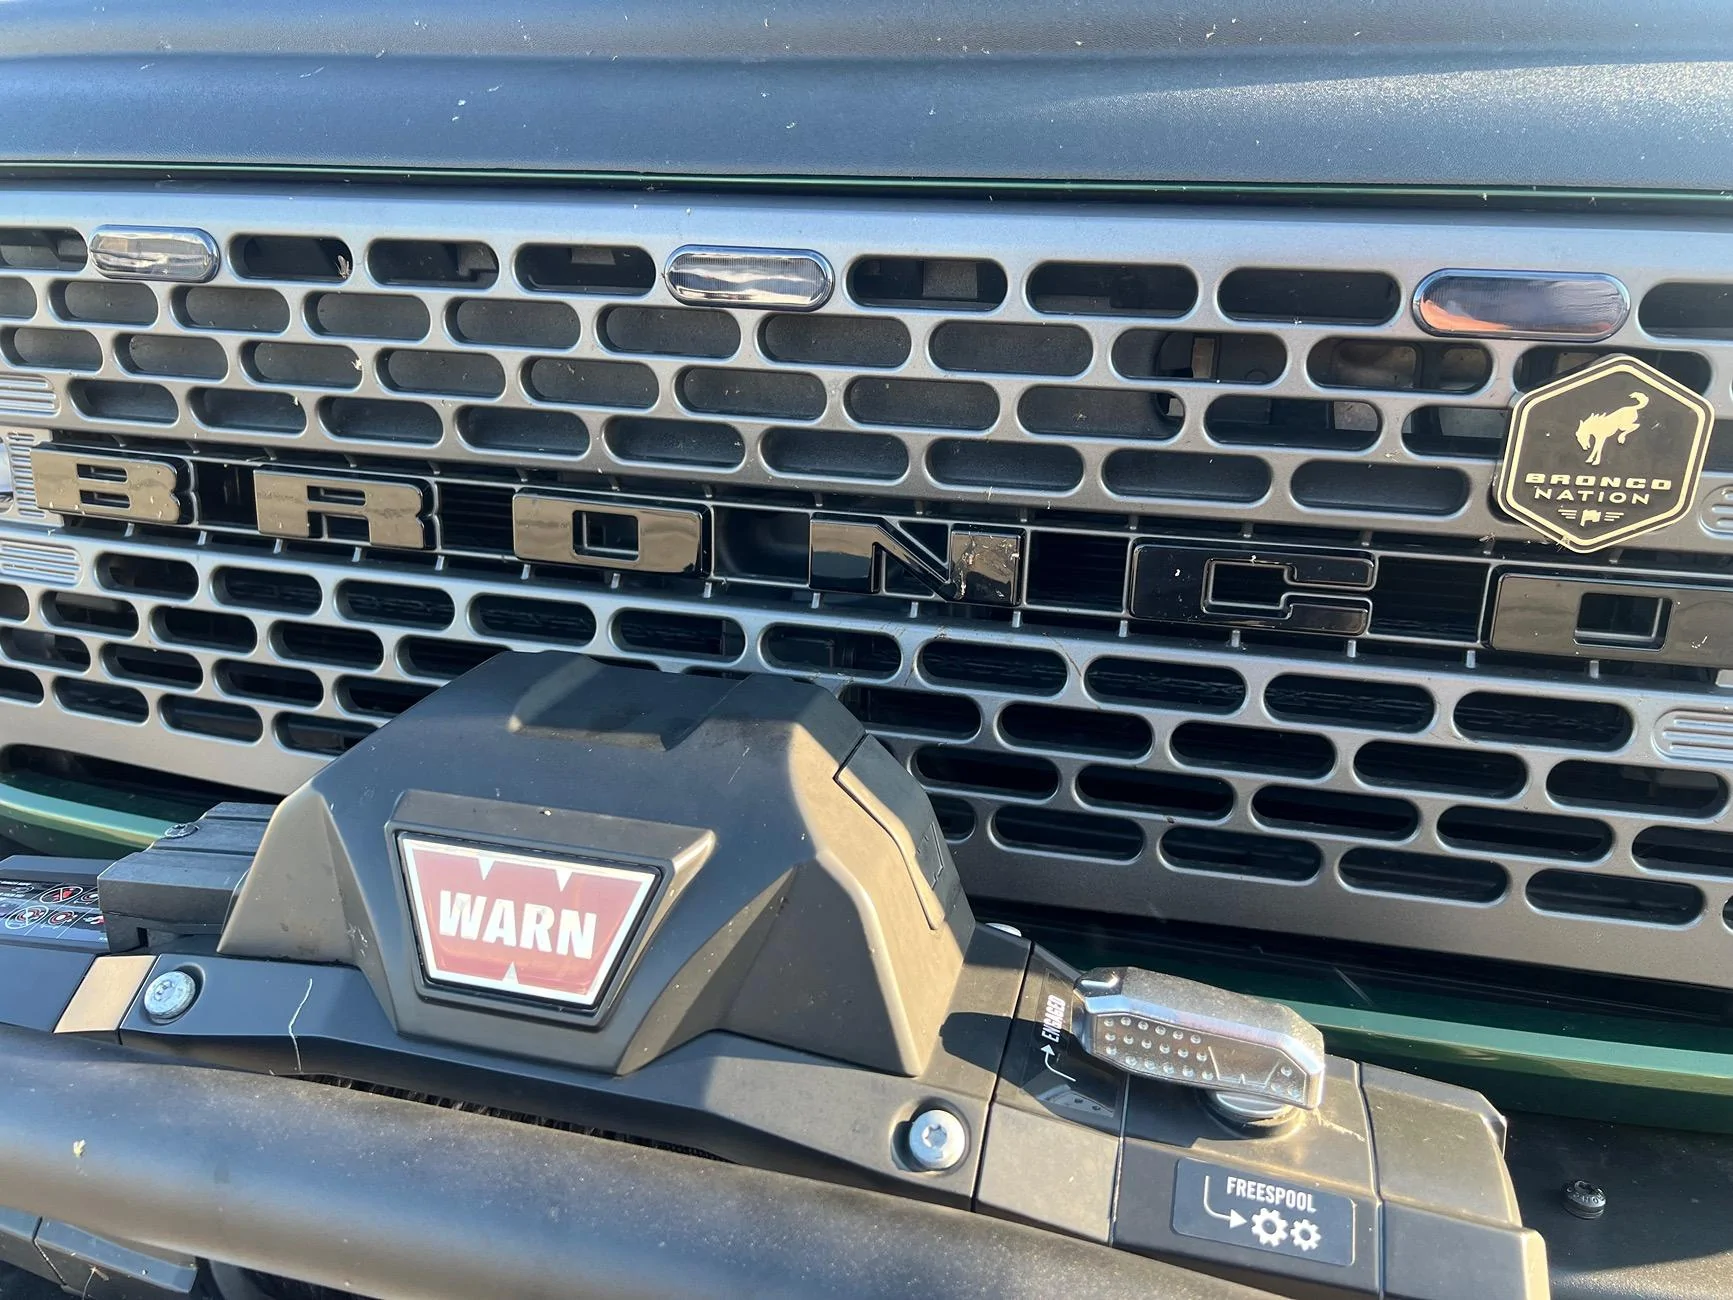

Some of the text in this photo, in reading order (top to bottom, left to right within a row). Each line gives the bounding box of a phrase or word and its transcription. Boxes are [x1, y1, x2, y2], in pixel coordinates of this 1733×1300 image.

[1525, 473, 1672, 490] BRONCO
[1533, 488, 1650, 505] NATION
[30, 442, 1733, 669] BRONCO
[438, 889, 597, 960] WARN
[1041, 994, 1066, 1043] ENGAGED
[1226, 1176, 1317, 1213] FREESPOOL
